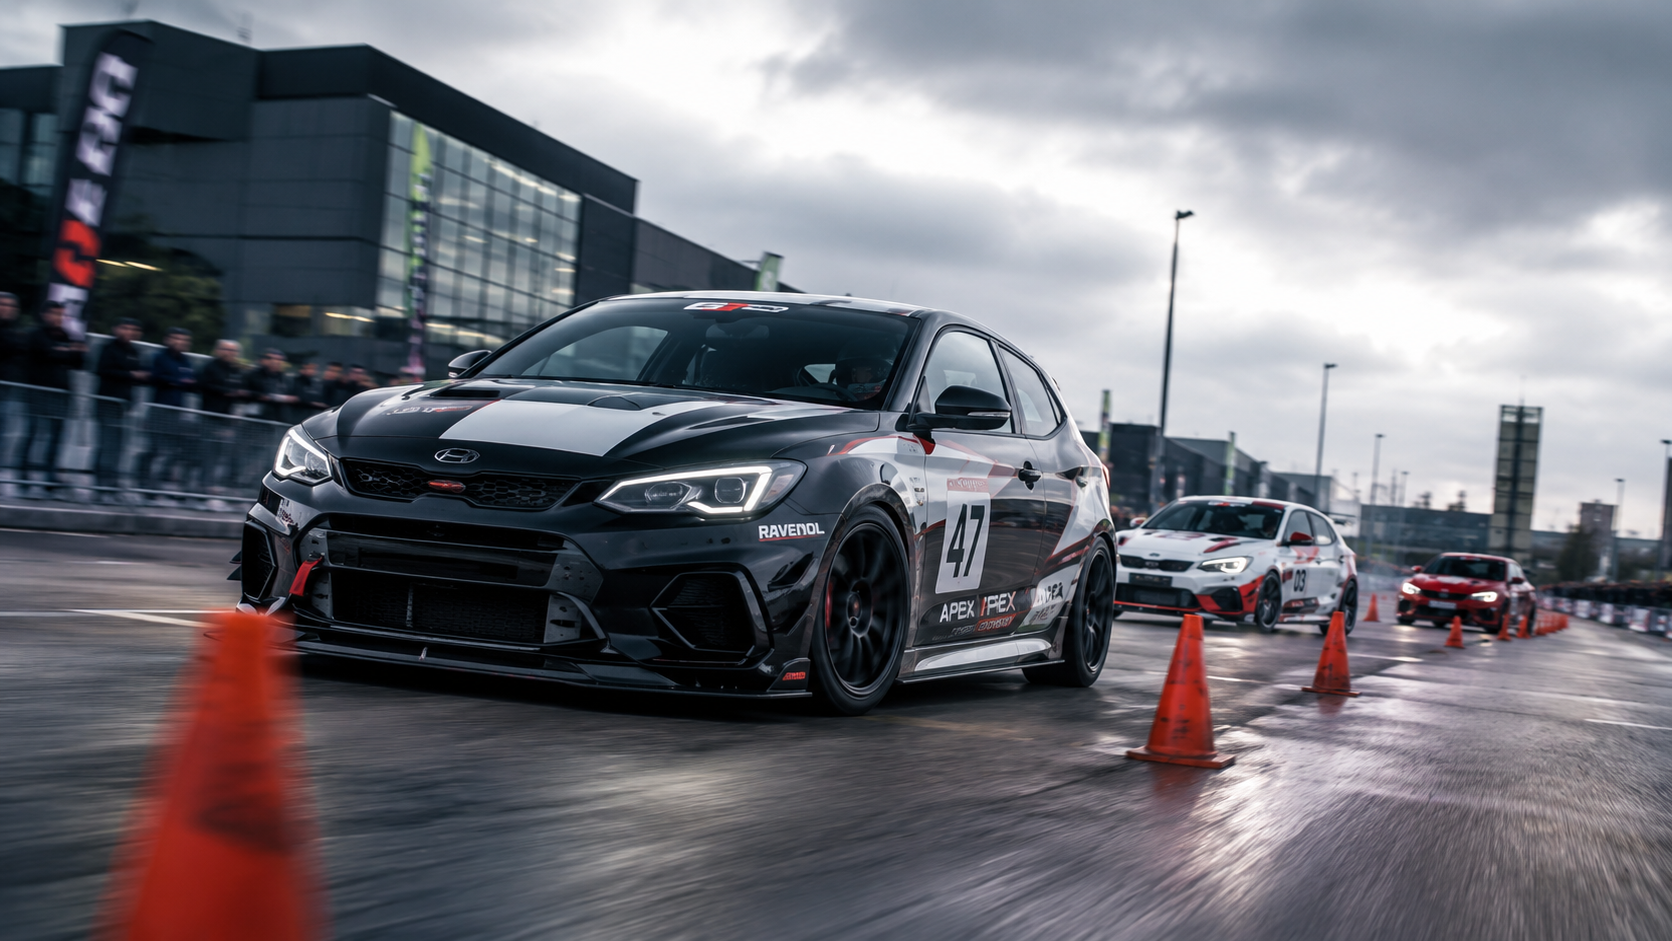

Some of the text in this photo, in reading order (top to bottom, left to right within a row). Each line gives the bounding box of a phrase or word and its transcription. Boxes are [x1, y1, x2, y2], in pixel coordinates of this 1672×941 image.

[758, 522, 825, 539] RAVENOL
[946, 503, 985, 578] 47
[1294, 569, 1306, 592] 03
[940, 600, 975, 623] APEX
